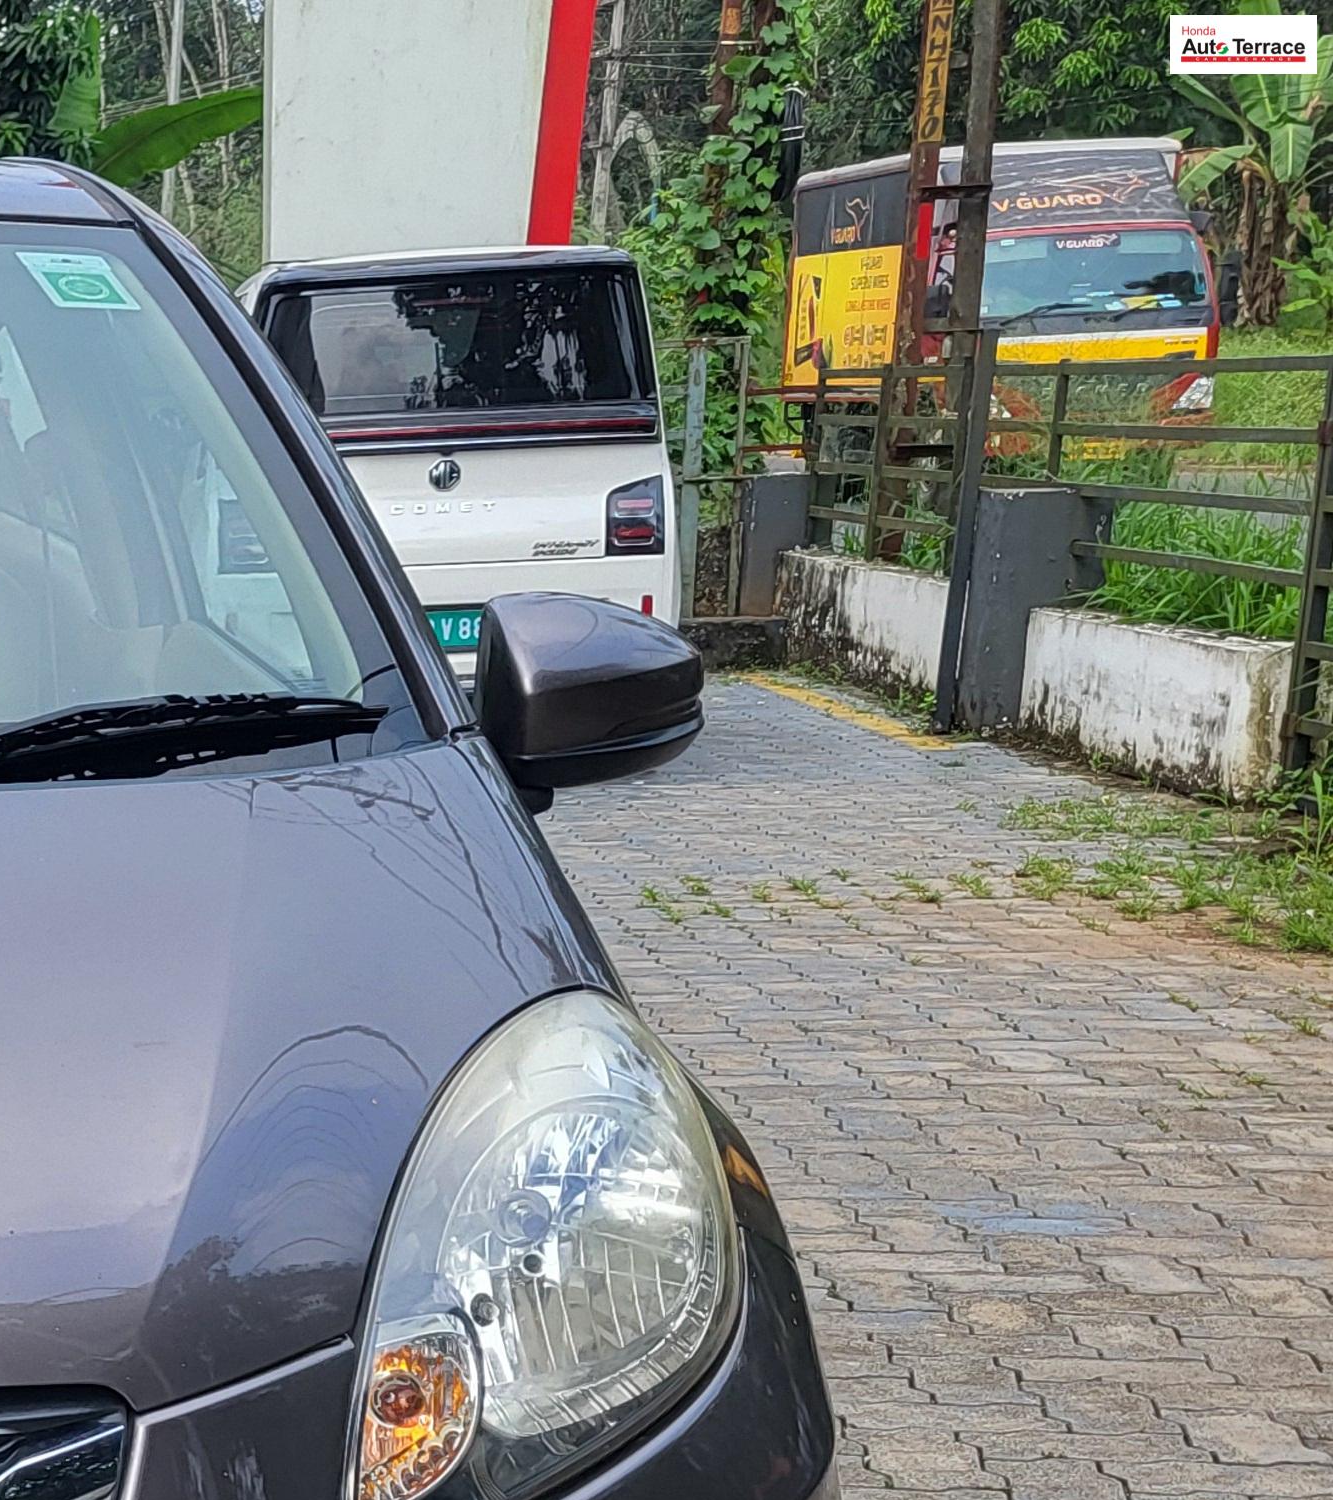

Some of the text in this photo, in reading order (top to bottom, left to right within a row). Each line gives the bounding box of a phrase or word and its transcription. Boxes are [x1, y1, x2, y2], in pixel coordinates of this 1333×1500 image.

[991, 193, 1104, 212] V-GUARD
[1055, 239, 1104, 249] V-GUARD
[430, 460, 460, 490] MG
[389, 500, 497, 516] COMET
